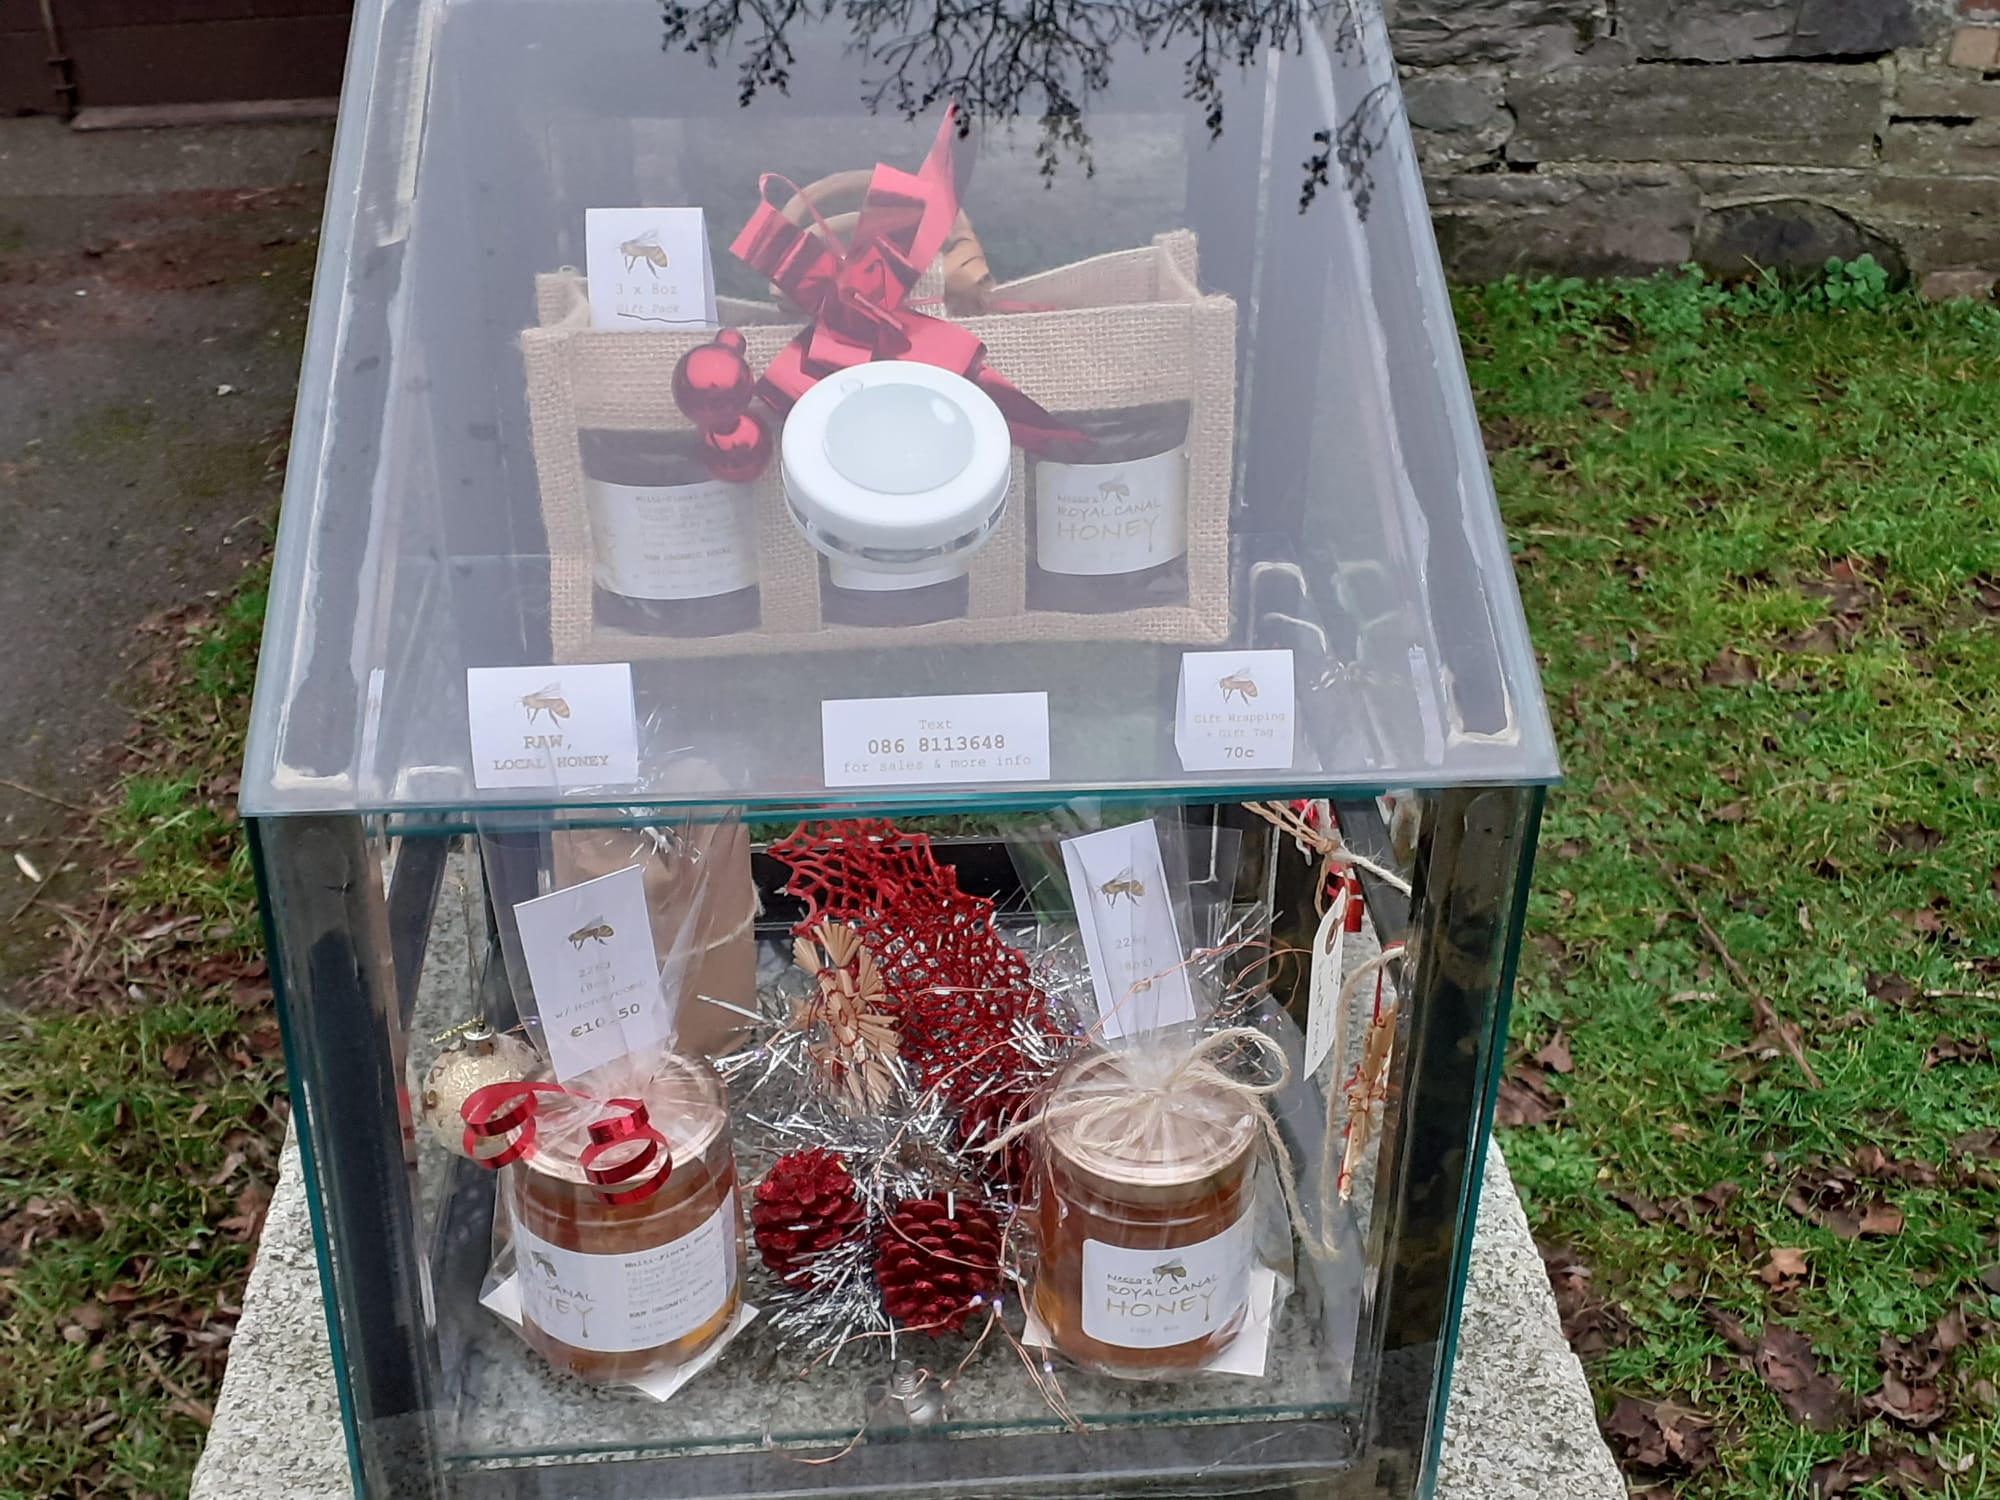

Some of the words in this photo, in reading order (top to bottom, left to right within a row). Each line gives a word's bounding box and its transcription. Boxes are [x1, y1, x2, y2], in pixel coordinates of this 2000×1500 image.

[615, 283, 624, 295] 3
[633, 286, 643, 295] x
[651, 283, 679, 295] 8oz
[1056, 506, 1113, 521] ROYAL
[1114, 499, 1161, 517] CANAL
[1056, 513, 1161, 553] HONEY
[918, 719, 953, 730] Text
[1193, 713, 1222, 724] Gift
[1228, 711, 1286, 723] Wrapping
[1254, 727, 1275, 738] Tag
[523, 734, 572, 750] RAW,
[868, 738, 905, 755] 086
[918, 734, 1006, 753] 8113648
[1223, 746, 1256, 759] 70c
[493, 758, 547, 771] LOCAL
[556, 755, 609, 768] HONEY
[843, 762, 870, 774] for
[879, 759, 924, 772] sales
[933, 760, 942, 769] &
[950, 757, 987, 769] more
[996, 754, 1032, 766] info
[1106, 1284, 1165, 1301] ROYAL
[1168, 1274, 1220, 1296] CANAL
[1106, 1285, 1218, 1323] HONEY
